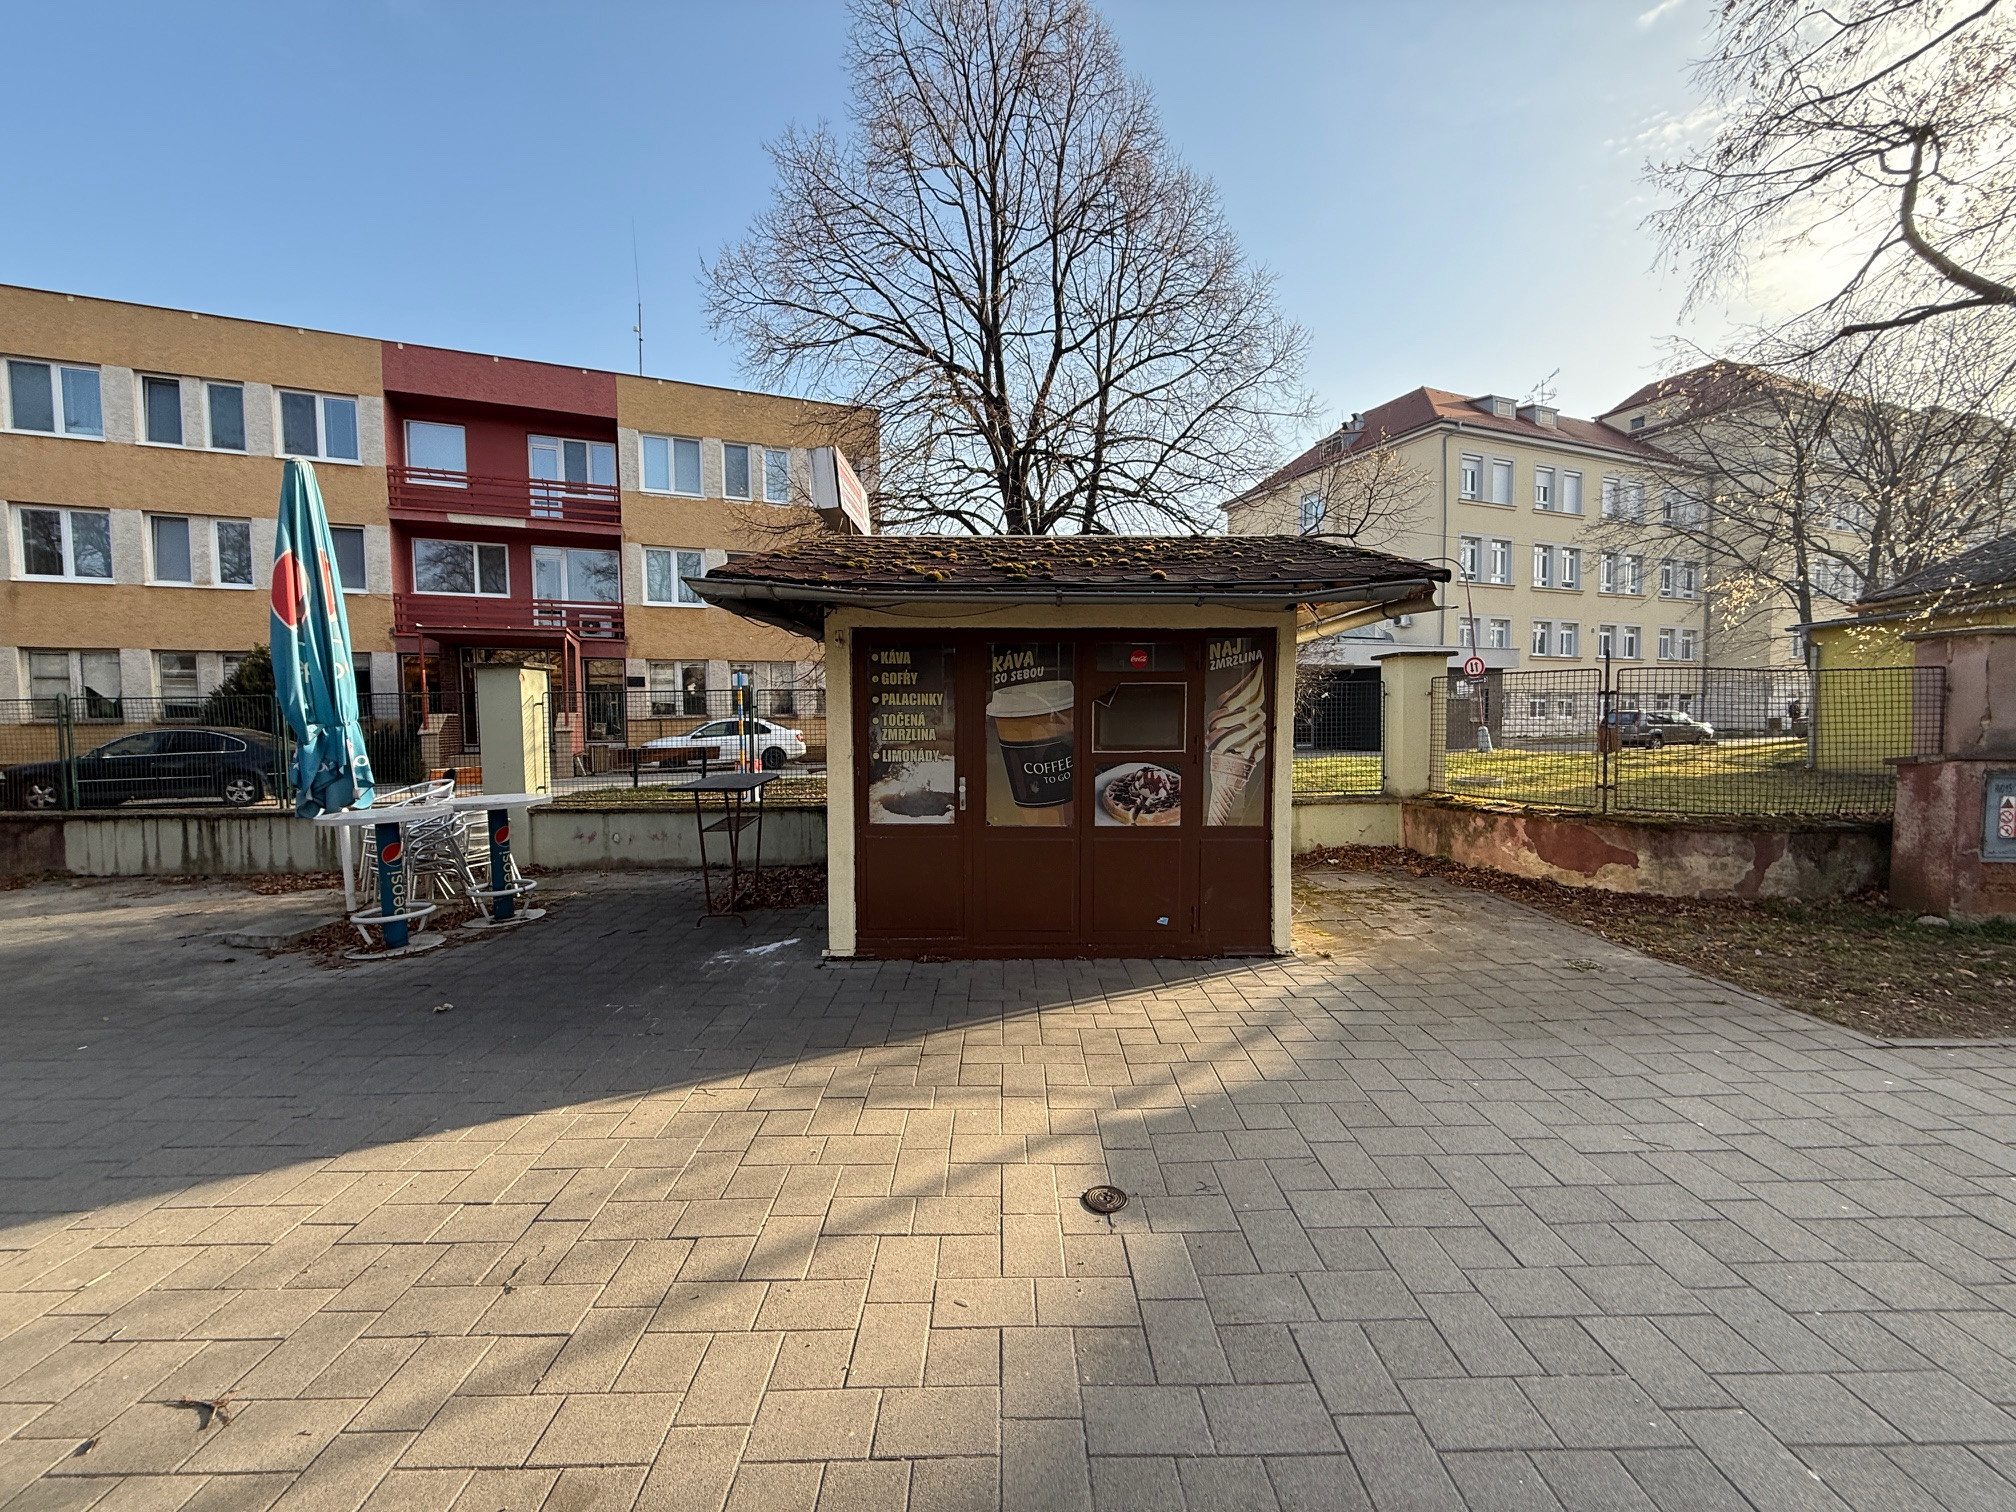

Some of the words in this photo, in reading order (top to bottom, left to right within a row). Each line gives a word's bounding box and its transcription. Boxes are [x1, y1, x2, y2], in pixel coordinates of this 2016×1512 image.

[881, 649, 911, 665] KÁVA
[1210, 638, 1242, 660] NAJ
[992, 650, 1034, 672] KÁVA
[1210, 649, 1263, 671] ZMRZLINA
[994, 672, 1008, 684] SO
[1010, 666, 1044, 681] SEBOU
[881, 693, 943, 706] PALACINKY
[881, 711, 926, 726] TOČENÁ
[881, 728, 937, 741] ZMRZLINA
[882, 747, 940, 762] LIMONÁDY
[1023, 756, 1073, 775] COFFEE
[1057, 771, 1071, 782] GO
